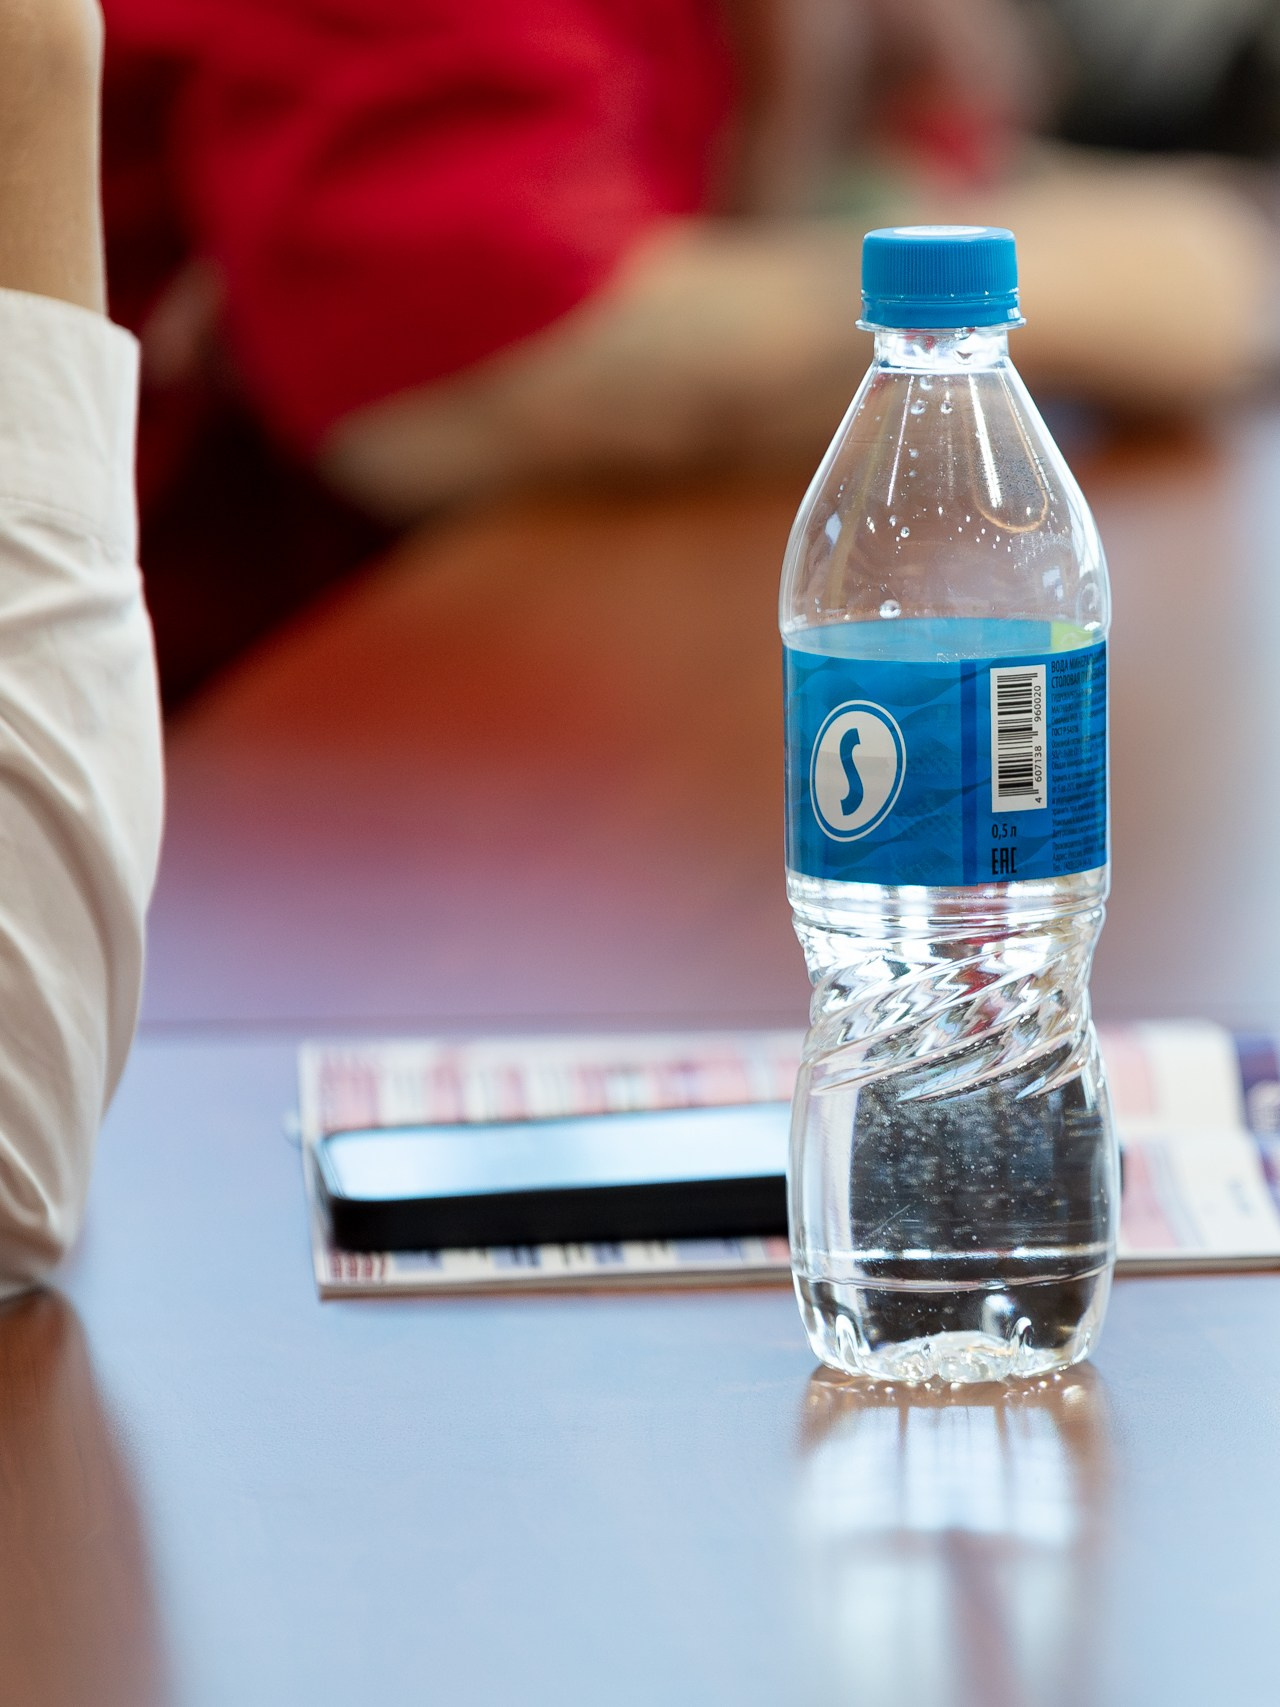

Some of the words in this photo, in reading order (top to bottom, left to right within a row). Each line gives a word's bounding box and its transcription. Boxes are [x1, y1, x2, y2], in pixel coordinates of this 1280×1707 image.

[1051, 659, 1069, 674] ВОДА
[1051, 671, 1081, 689] СТОЛОВАЯ
[1033, 685, 1042, 723] 960020
[839, 727, 864, 816] S
[1034, 745, 1042, 783] 607138
[1034, 796, 1042, 804] 4
[991, 823, 1008, 841] 0,5
[1010, 825, 1017, 838] л
